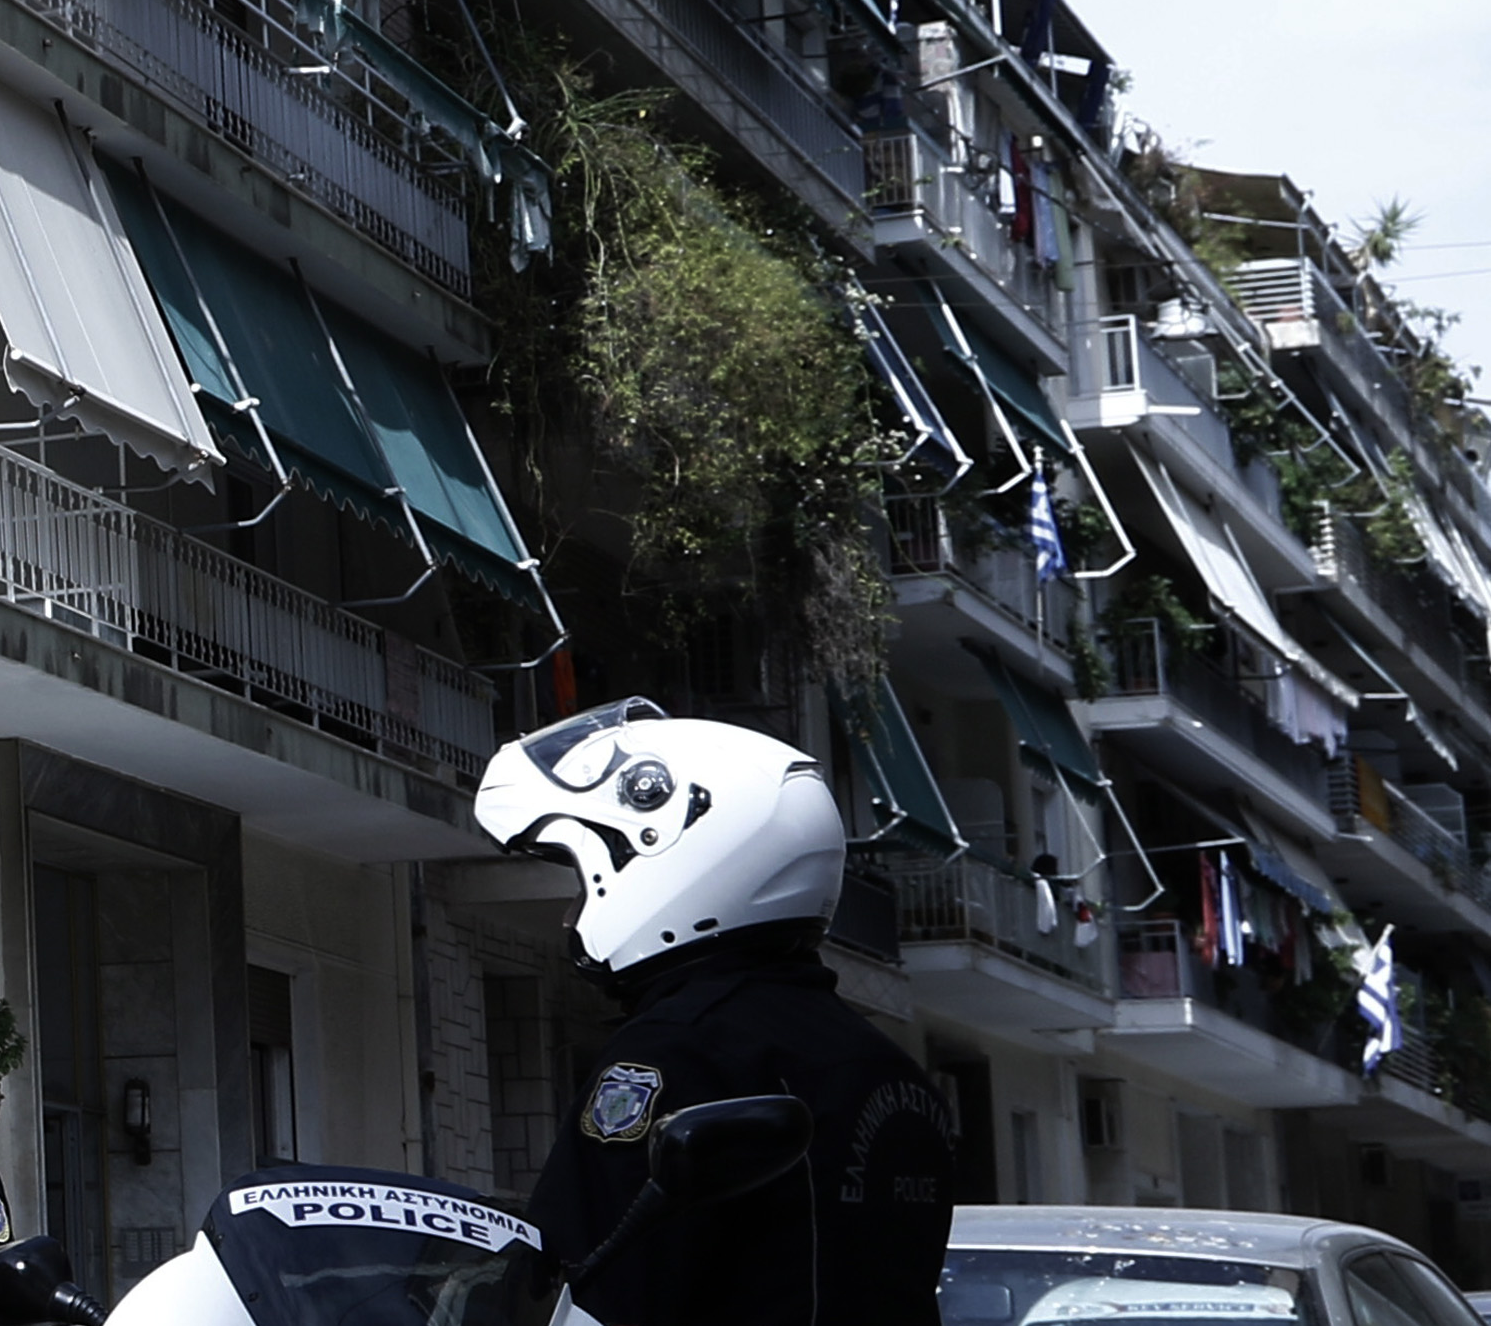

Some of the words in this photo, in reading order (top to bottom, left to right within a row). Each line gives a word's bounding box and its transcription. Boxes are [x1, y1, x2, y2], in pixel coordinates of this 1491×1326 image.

[893, 1176, 937, 1203] POLICE
[243, 1184, 377, 1205] ΕΛΛΗΝΙΚΗ
[383, 1189, 532, 1241] ΑΣΤΥΝΟΜΙΑ
[291, 1202, 493, 1247] POLICE
